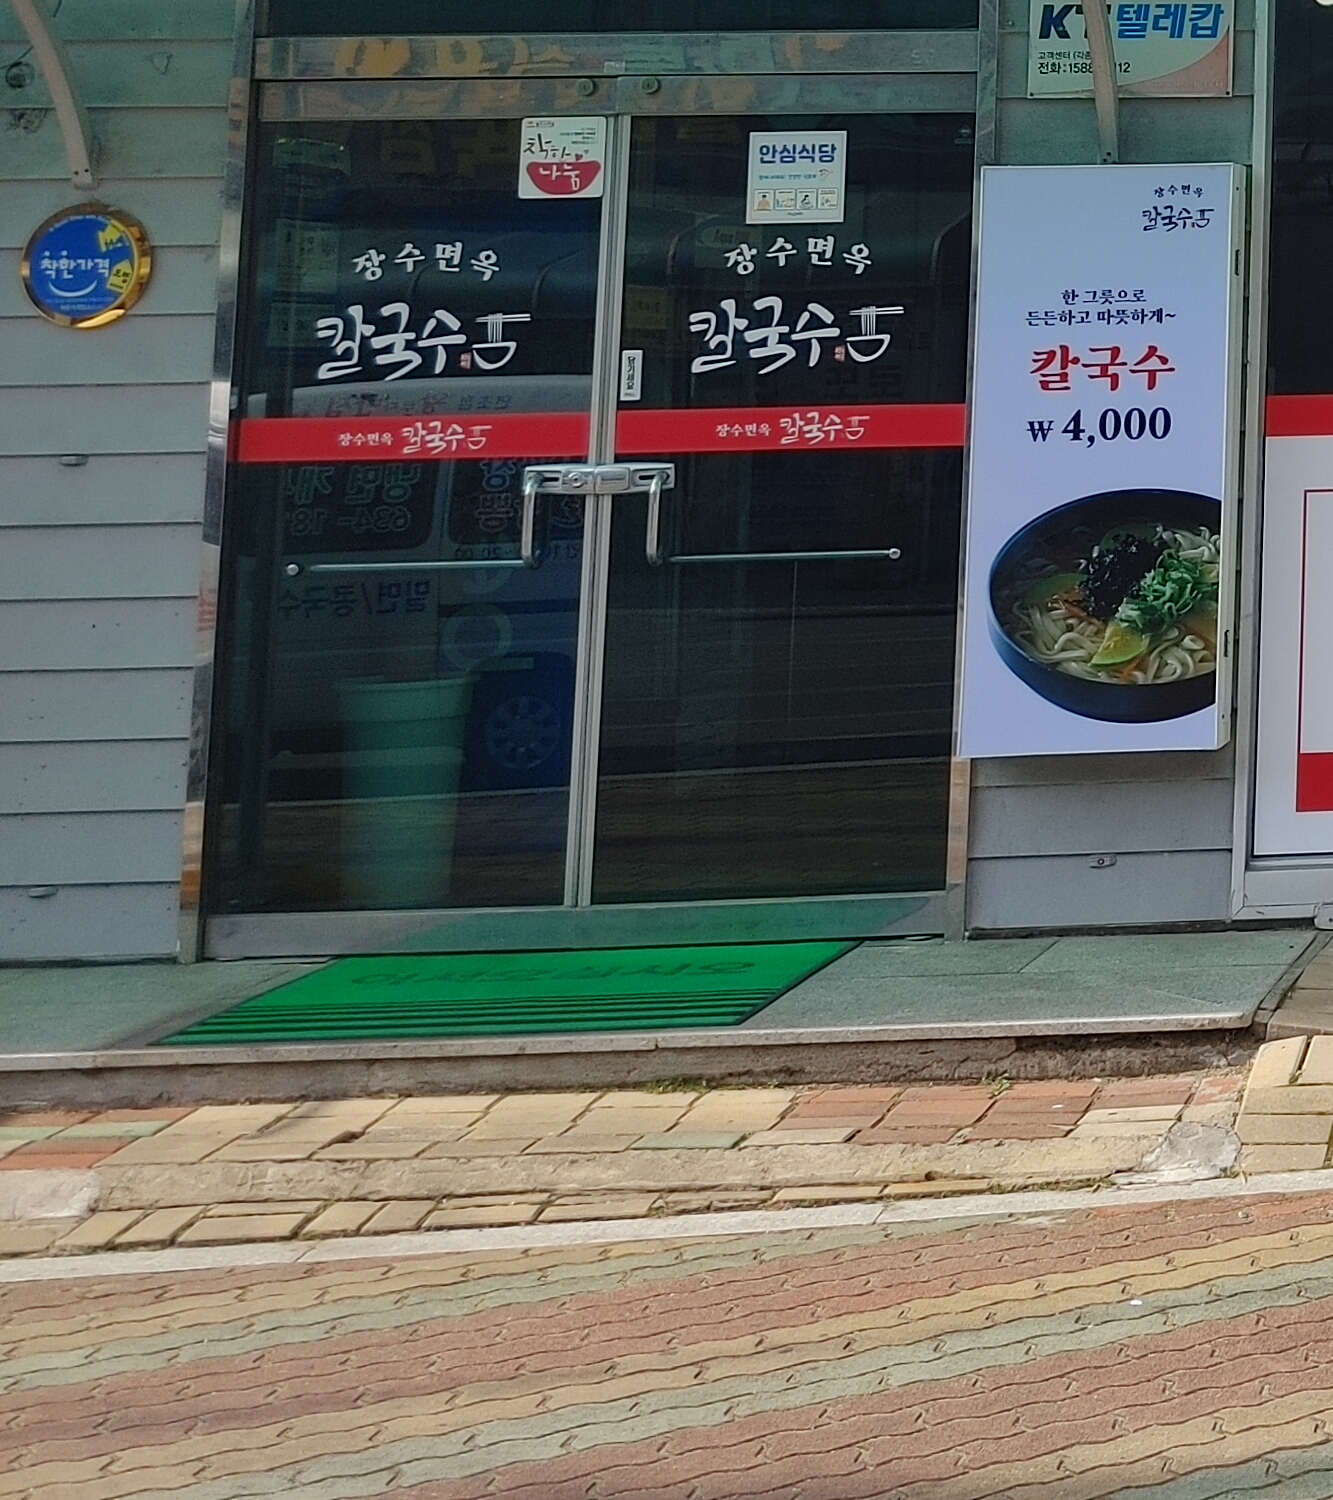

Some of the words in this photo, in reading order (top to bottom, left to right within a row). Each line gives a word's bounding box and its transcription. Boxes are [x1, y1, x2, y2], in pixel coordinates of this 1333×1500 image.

[1116, 3, 1224, 39] 텔레캅
[1038, 51, 1070, 60] 고객센터
[759, 143, 837, 164] 안심식당
[539, 164, 580, 191] 나눔
[1142, 205, 1193, 232] 칼국수
[41, 250, 110, 279] 착한가격
[352, 241, 500, 282] 장수면옥
[724, 235, 872, 275] 장수면옥
[1061, 289, 1080, 306] 한
[1083, 289, 1147, 305] 그릇으로
[1025, 309, 1092, 327] 든든하고
[316, 301, 468, 381] 칼국수
[689, 296, 841, 375] 칼국수
[1030, 345, 1176, 392] 칼국수
[338, 433, 393, 446] 장수면옥
[401, 420, 465, 454] 칼국수
[716, 423, 771, 437] 장수면옥
[779, 412, 844, 445] 칼국수
